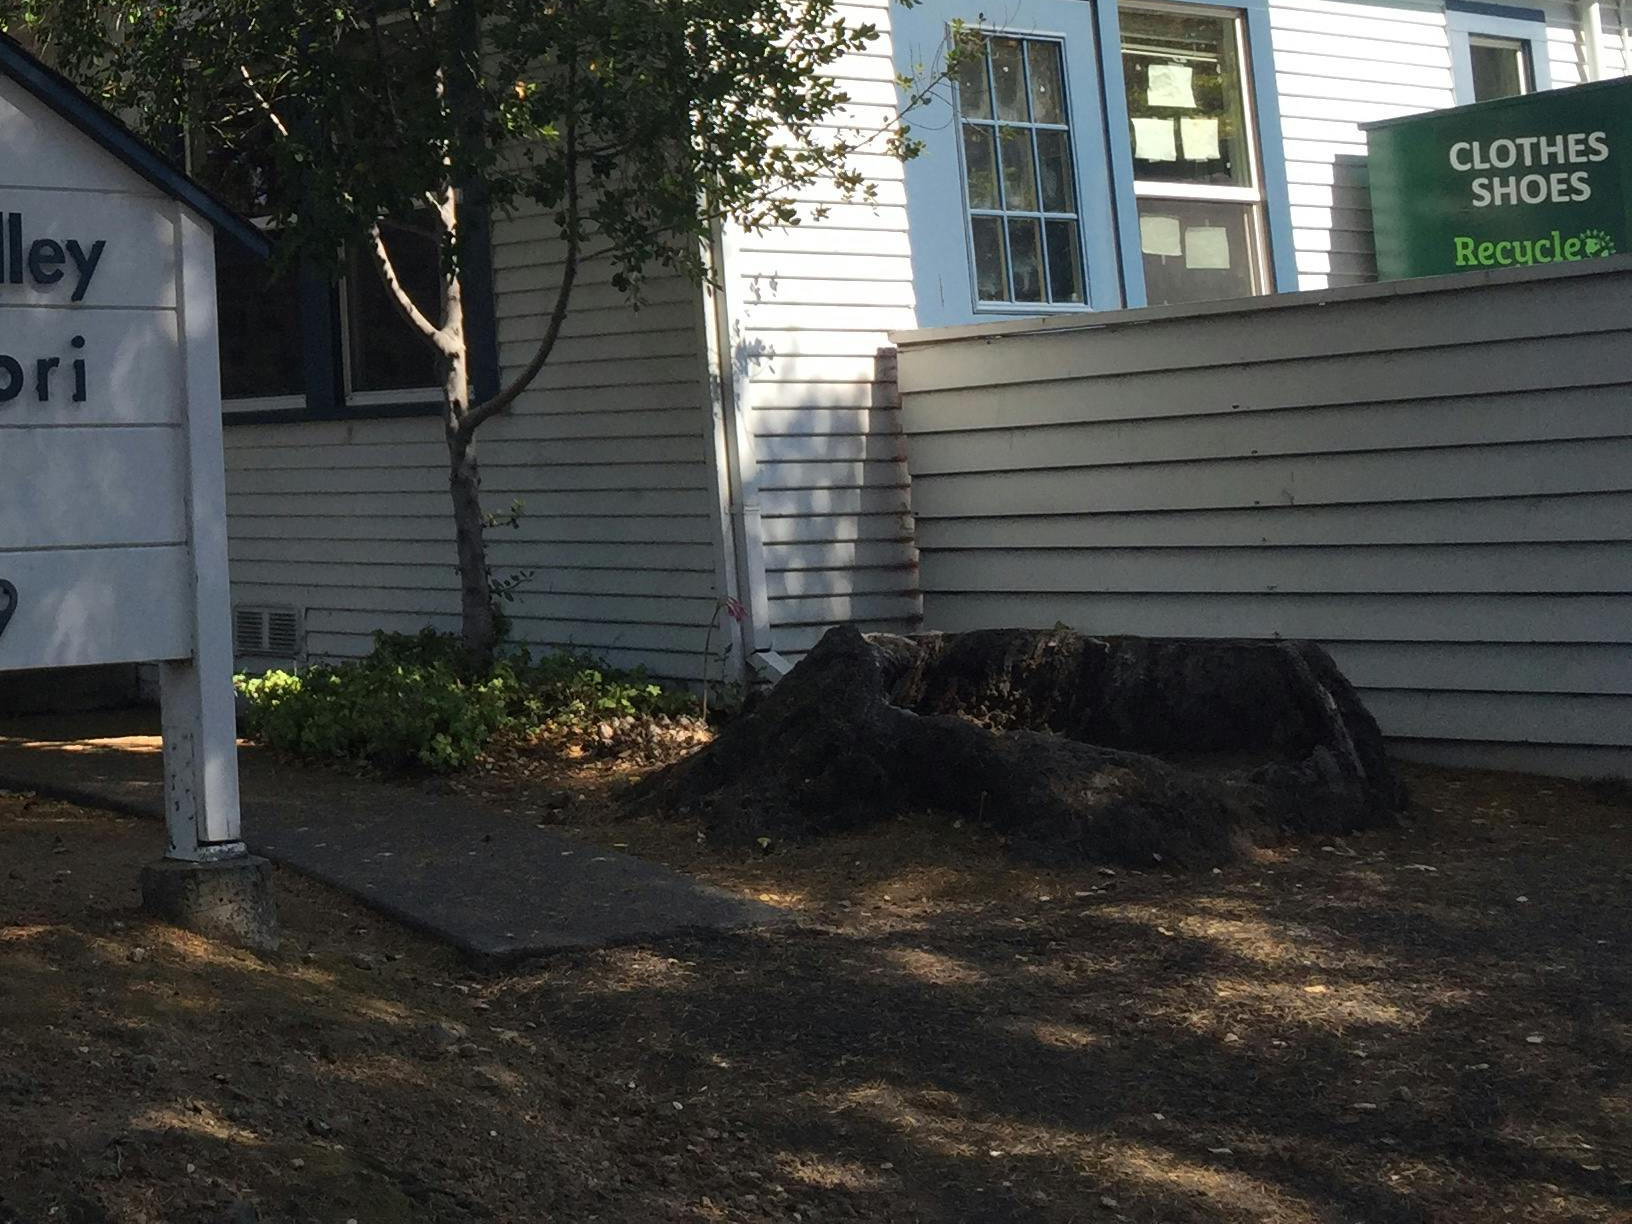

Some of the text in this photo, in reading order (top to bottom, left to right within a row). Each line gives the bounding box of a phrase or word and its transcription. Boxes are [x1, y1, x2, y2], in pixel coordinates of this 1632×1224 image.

[1449, 131, 1609, 171] CLOTHES
[1472, 171, 1591, 207] SHOES
[1454, 231, 1581, 267] Recycle
